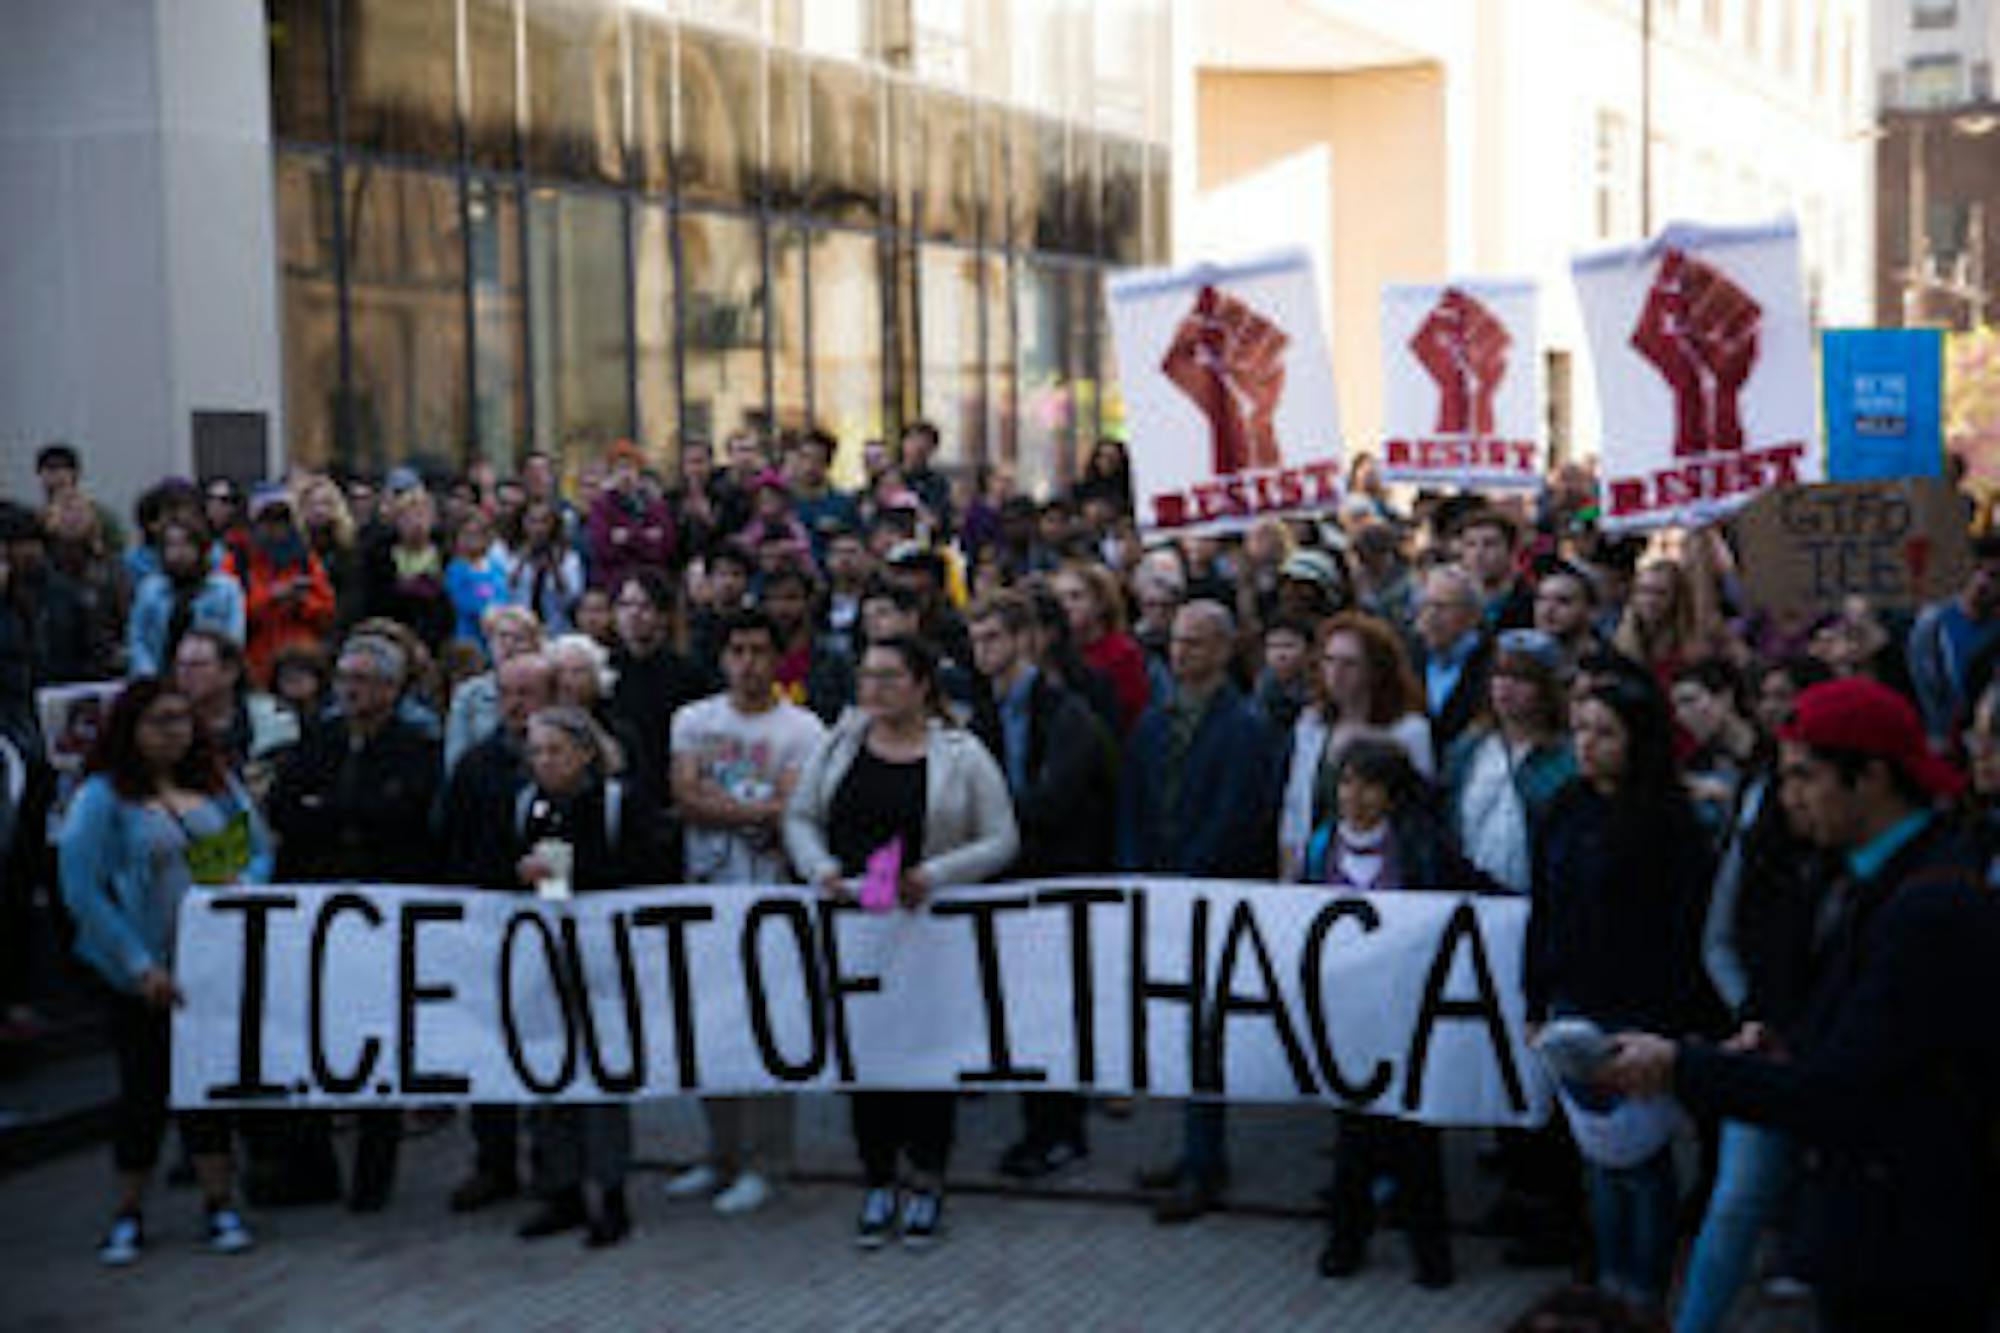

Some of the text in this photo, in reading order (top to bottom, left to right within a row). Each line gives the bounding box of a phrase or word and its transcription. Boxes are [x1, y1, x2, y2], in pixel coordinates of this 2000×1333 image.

[1386, 440, 1537, 470] RESIST
[1609, 442, 1804, 517] RESIST
[1152, 459, 1340, 528] RESIST
[498, 905, 714, 1096] OUT
[740, 898, 880, 1083] OF
[931, 888, 1529, 1112] ITHACA
